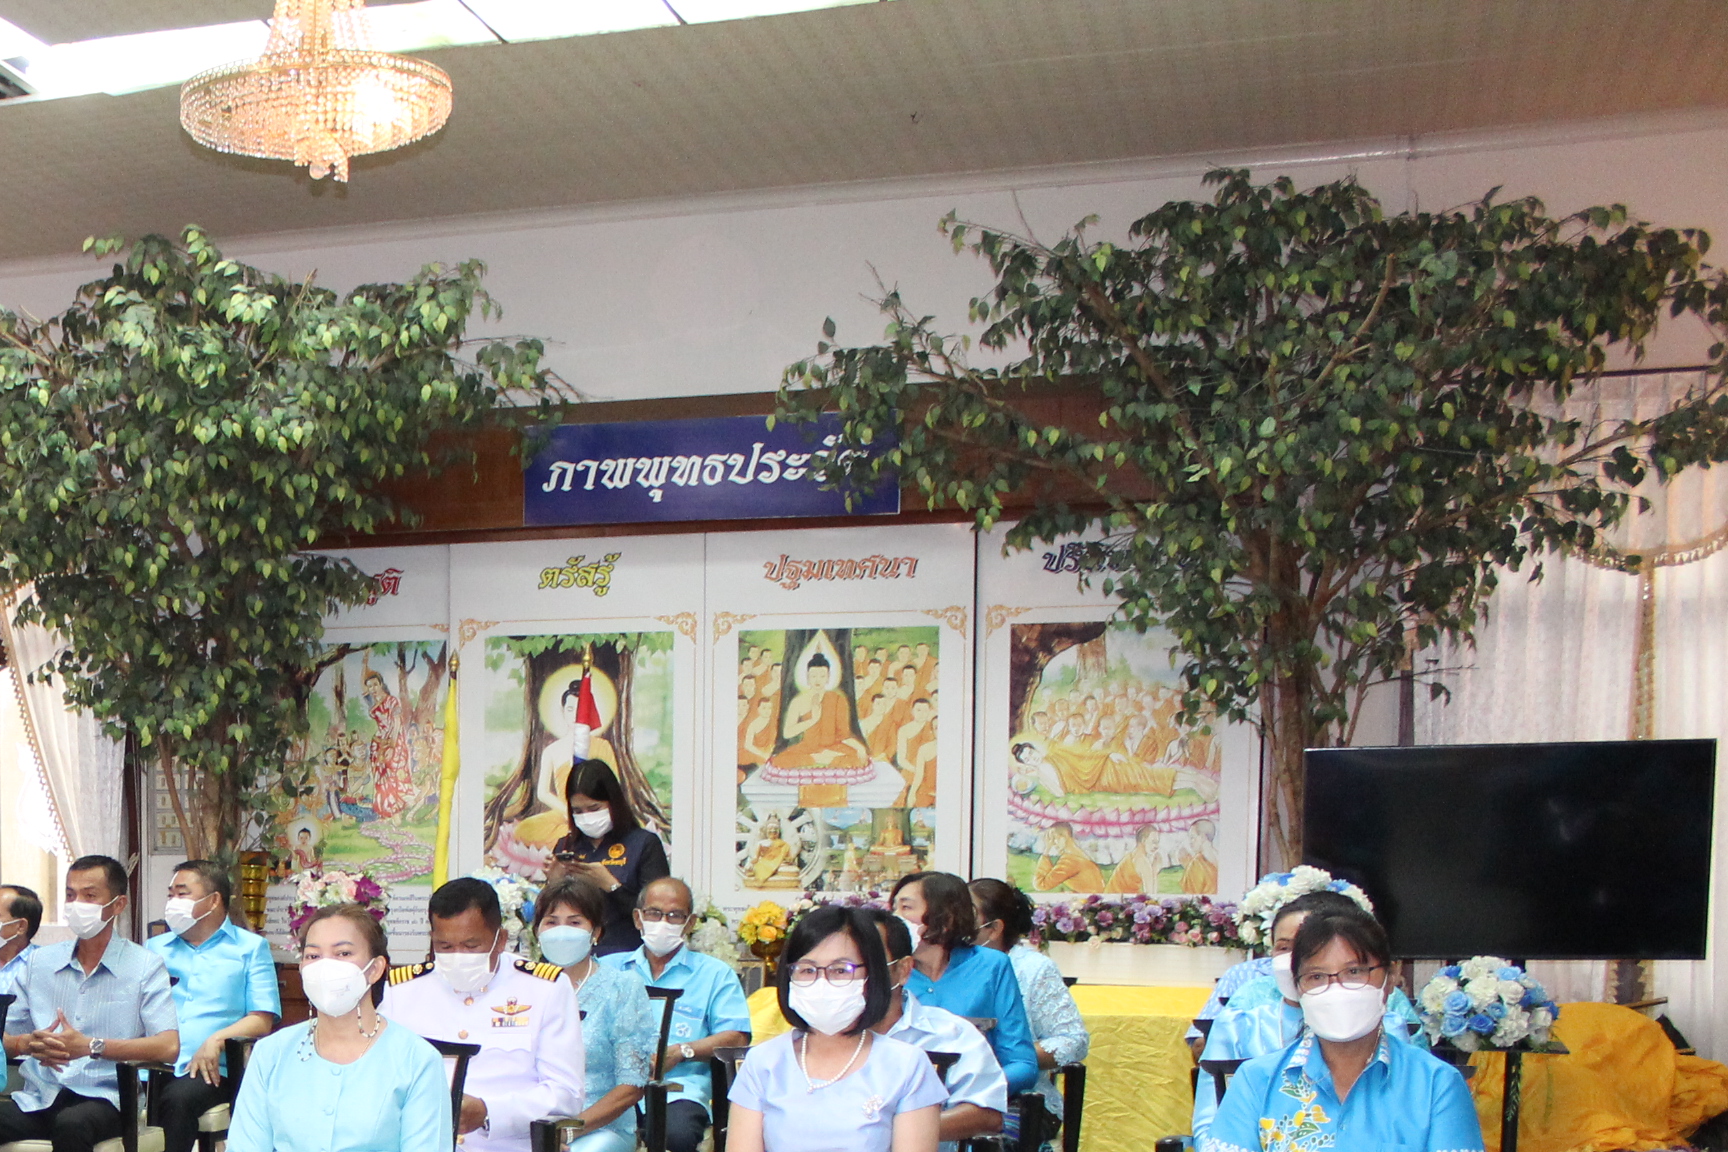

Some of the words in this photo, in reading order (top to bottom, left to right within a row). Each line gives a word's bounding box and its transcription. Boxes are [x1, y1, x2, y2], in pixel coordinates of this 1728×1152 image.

[538, 551, 622, 597] ตรัสรู้
[763, 553, 919, 590] ปฐมเทศนา
